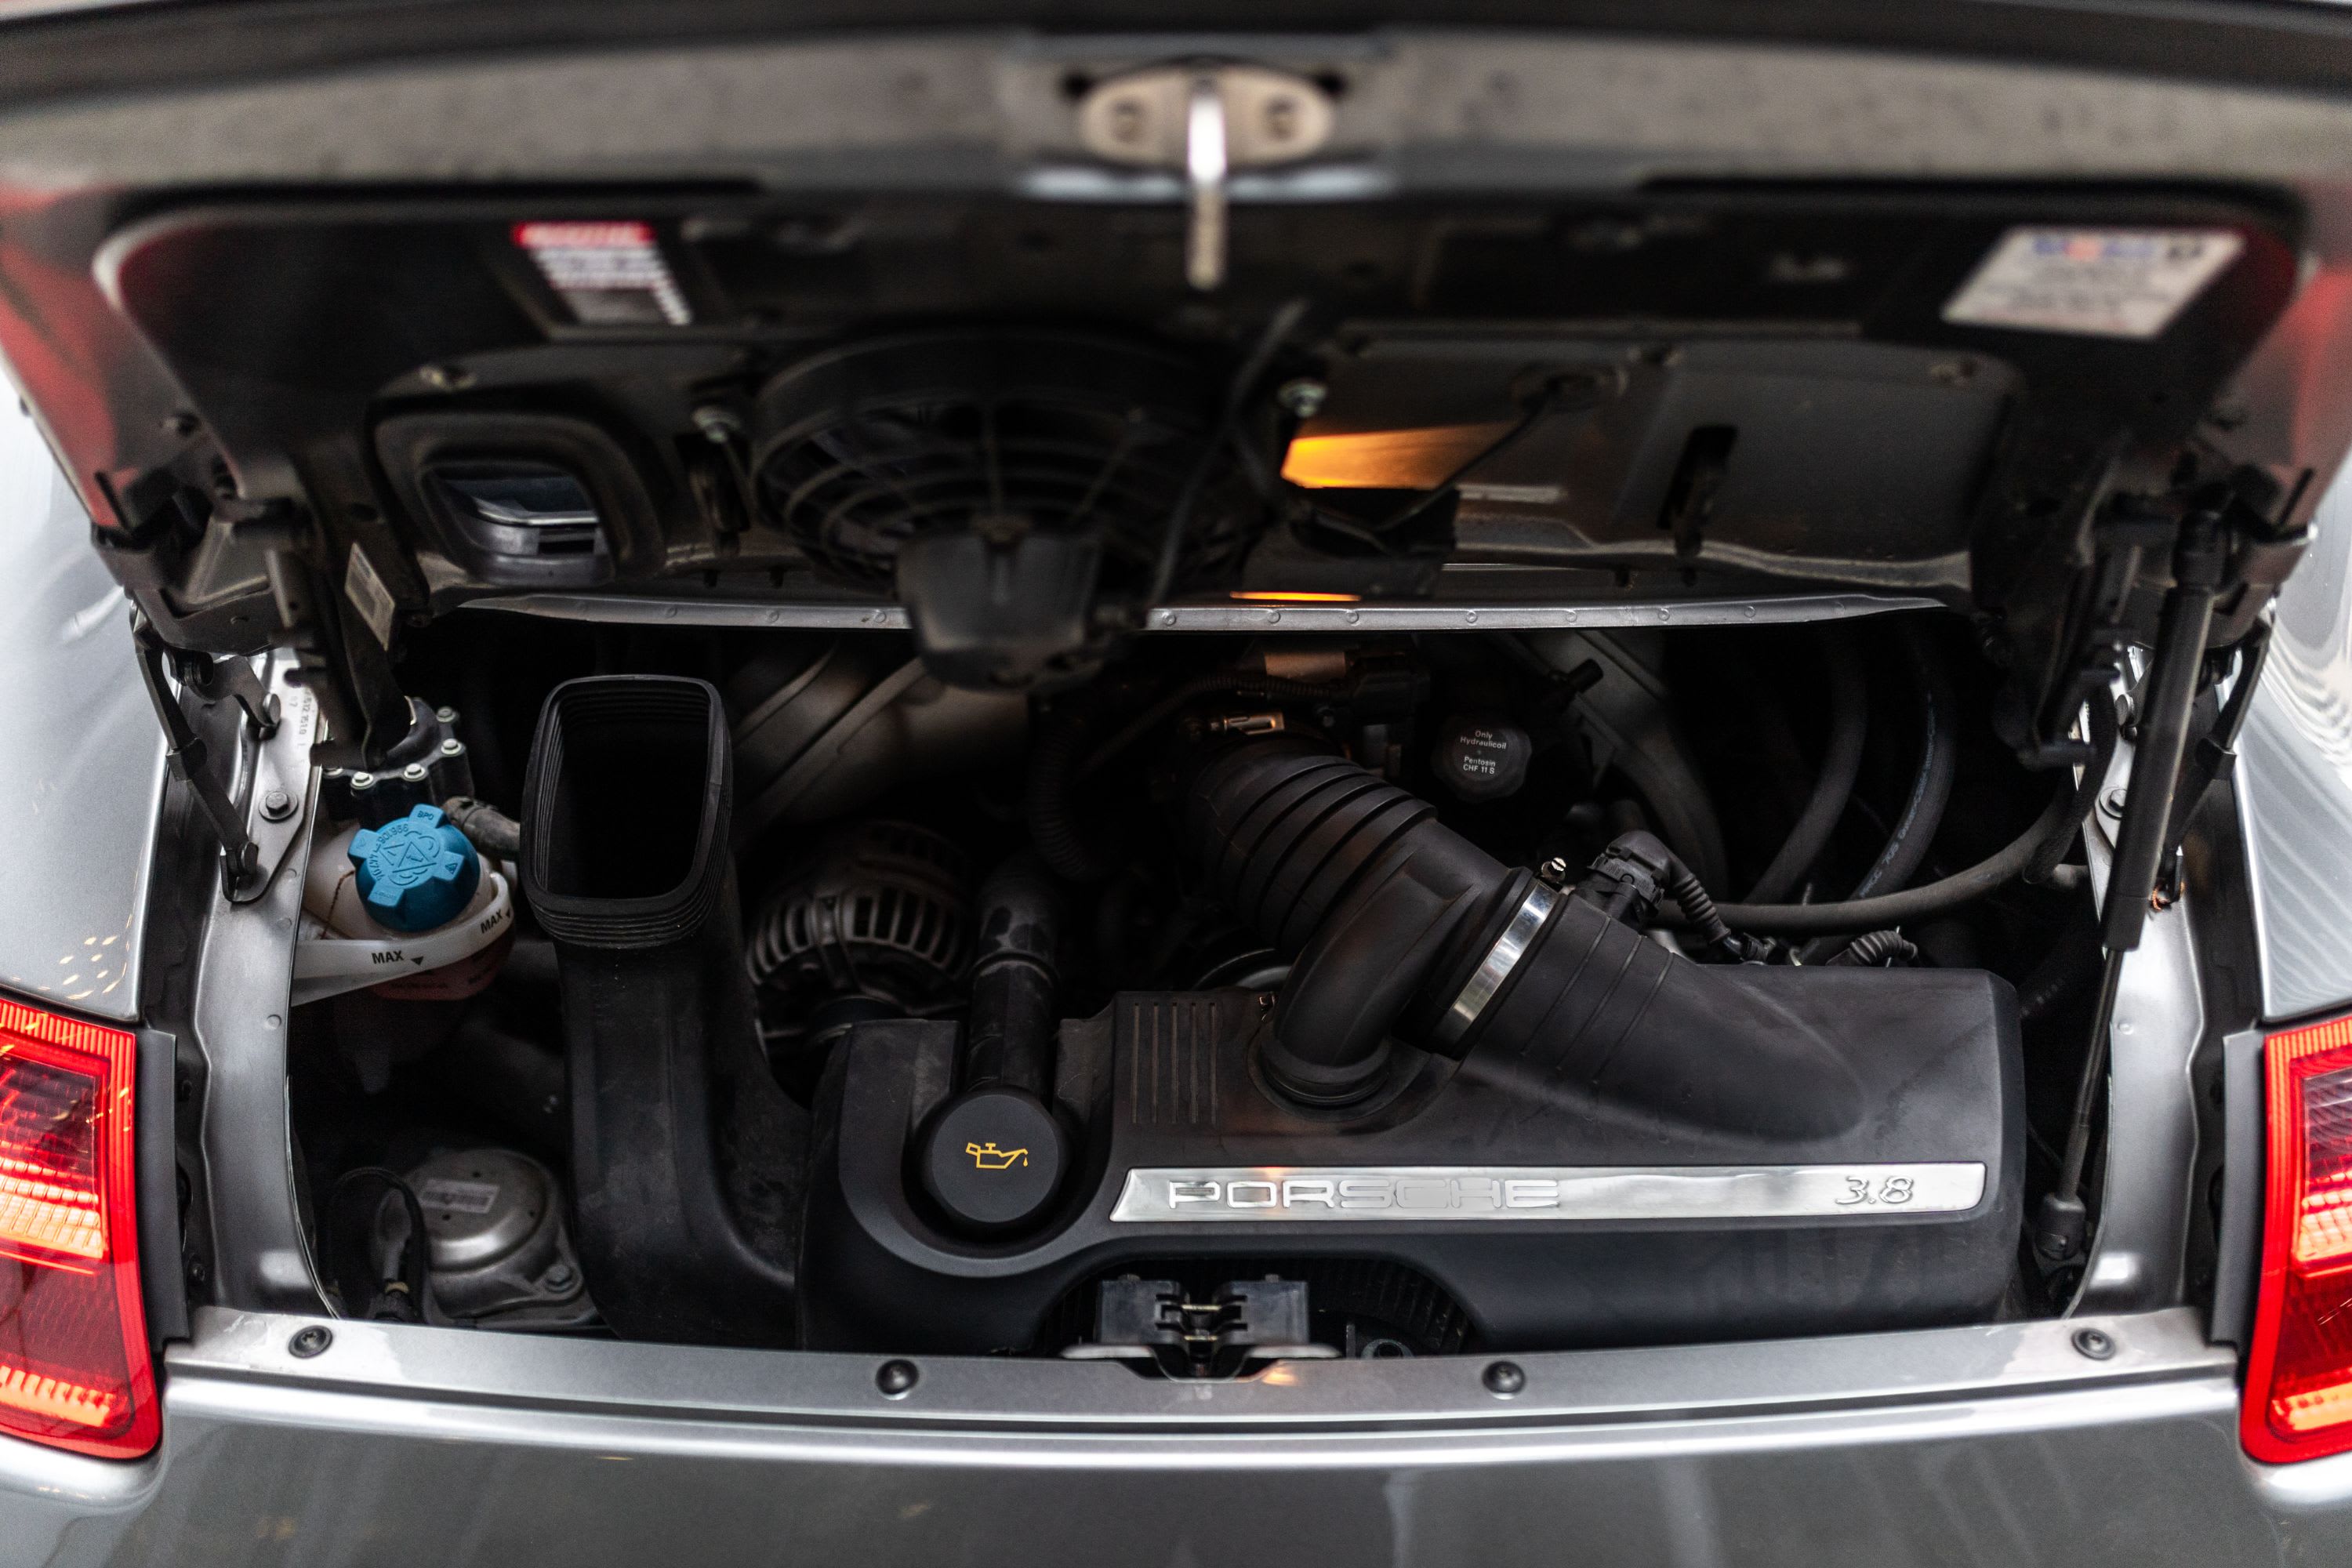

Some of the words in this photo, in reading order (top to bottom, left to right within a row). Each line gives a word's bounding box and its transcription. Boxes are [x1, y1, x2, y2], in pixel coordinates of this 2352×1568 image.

[1475, 730, 1493, 739] Only
[1460, 736, 1507, 750] Hydraulicoil
[1463, 764, 1479, 772] CHF
[1464, 756, 1496, 768] Pentosin
[479, 909, 503, 934] MAX
[371, 950, 405, 964] MAX
[1168, 1179, 1560, 1210] PORSCHE
[1835, 1176, 1914, 1205] 3.8
